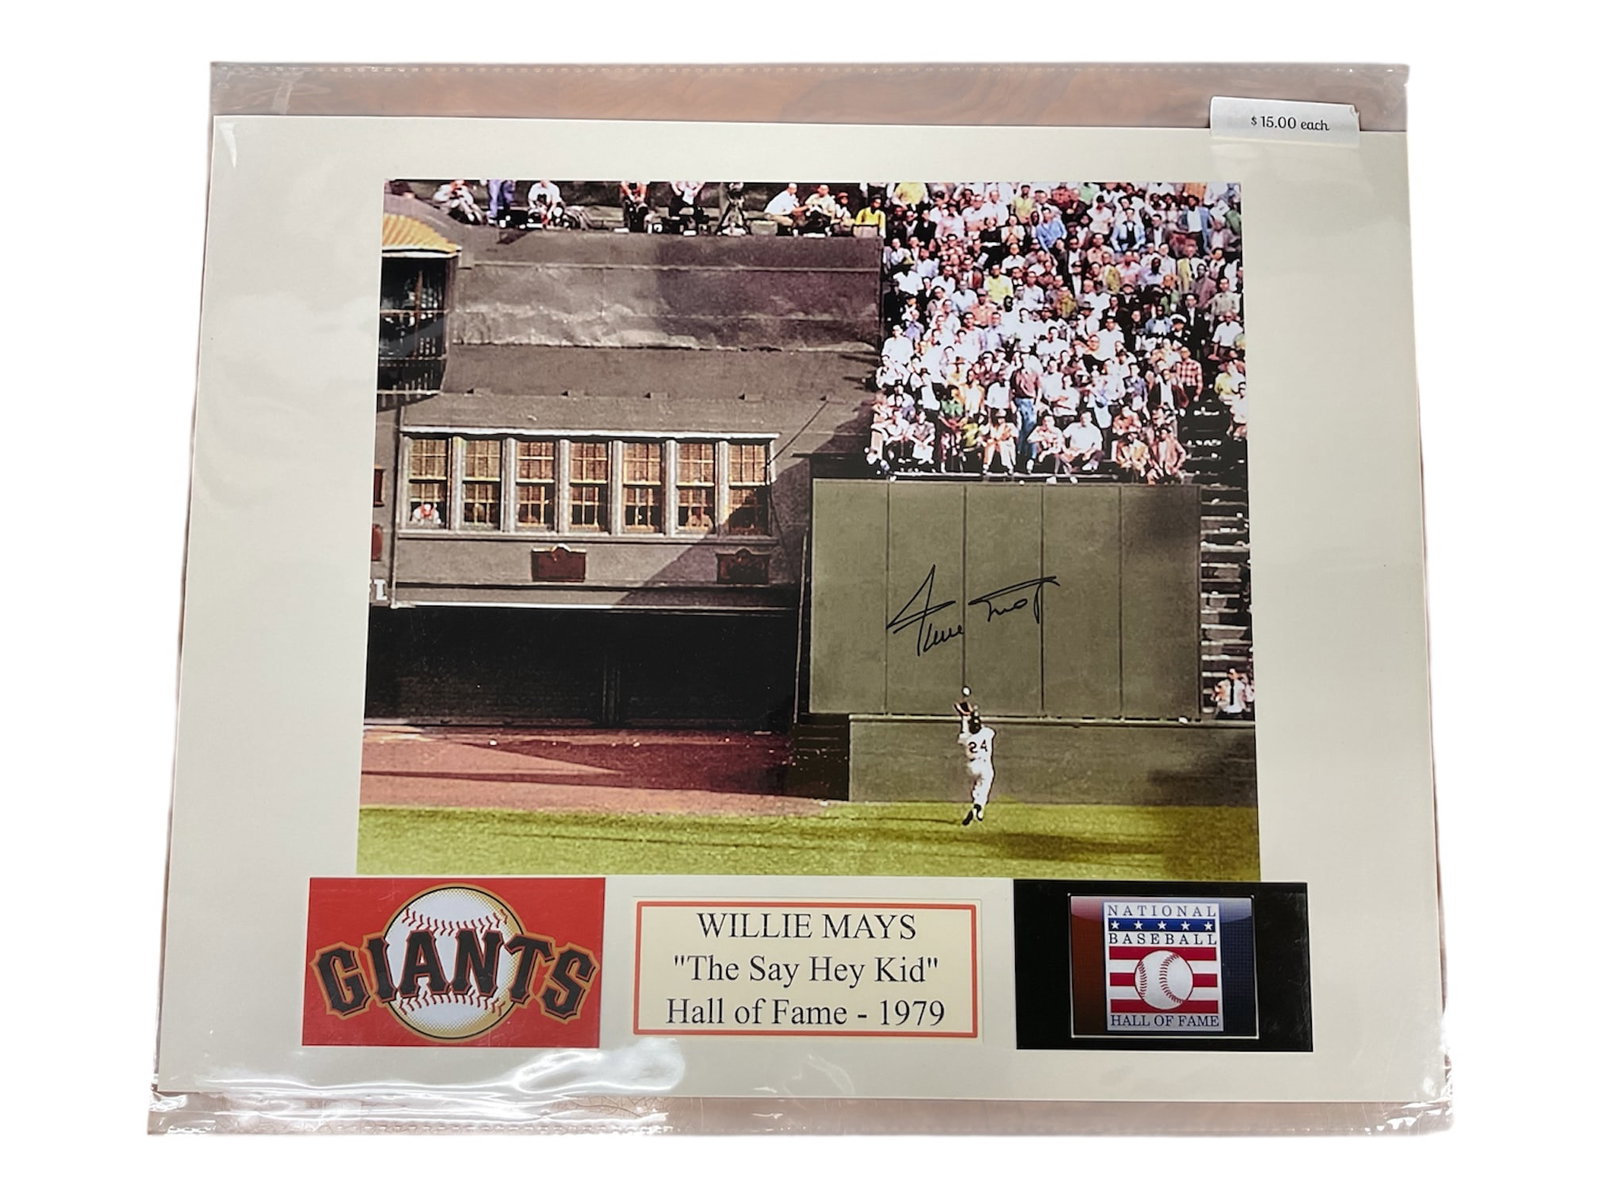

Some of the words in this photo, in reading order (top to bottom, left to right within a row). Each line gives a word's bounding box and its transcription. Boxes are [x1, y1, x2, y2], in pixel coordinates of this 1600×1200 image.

[1261, 115, 1297, 130] 15.00
[1300, 119, 1330, 132] each
[968, 739, 988, 754] 24
[1107, 904, 1216, 918] NATIONAL
[696, 912, 813, 940] WILLIE
[821, 914, 917, 941] MAYS
[1108, 933, 1218, 946] BASEBALL
[310, 926, 600, 1023] GIANTS
[673, 954, 740, 983] "The
[749, 955, 800, 988] Say
[808, 956, 866, 989] Hey
[874, 957, 939, 984] Kid"
[666, 998, 724, 1025] Hall
[734, 998, 766, 1025] of
[772, 999, 848, 1026] Fame
[879, 1000, 946, 1027] 1979
[1110, 1014, 1151, 1027] HALL
[1153, 1015, 1175, 1028] OF
[1178, 1015, 1220, 1028] FAME
